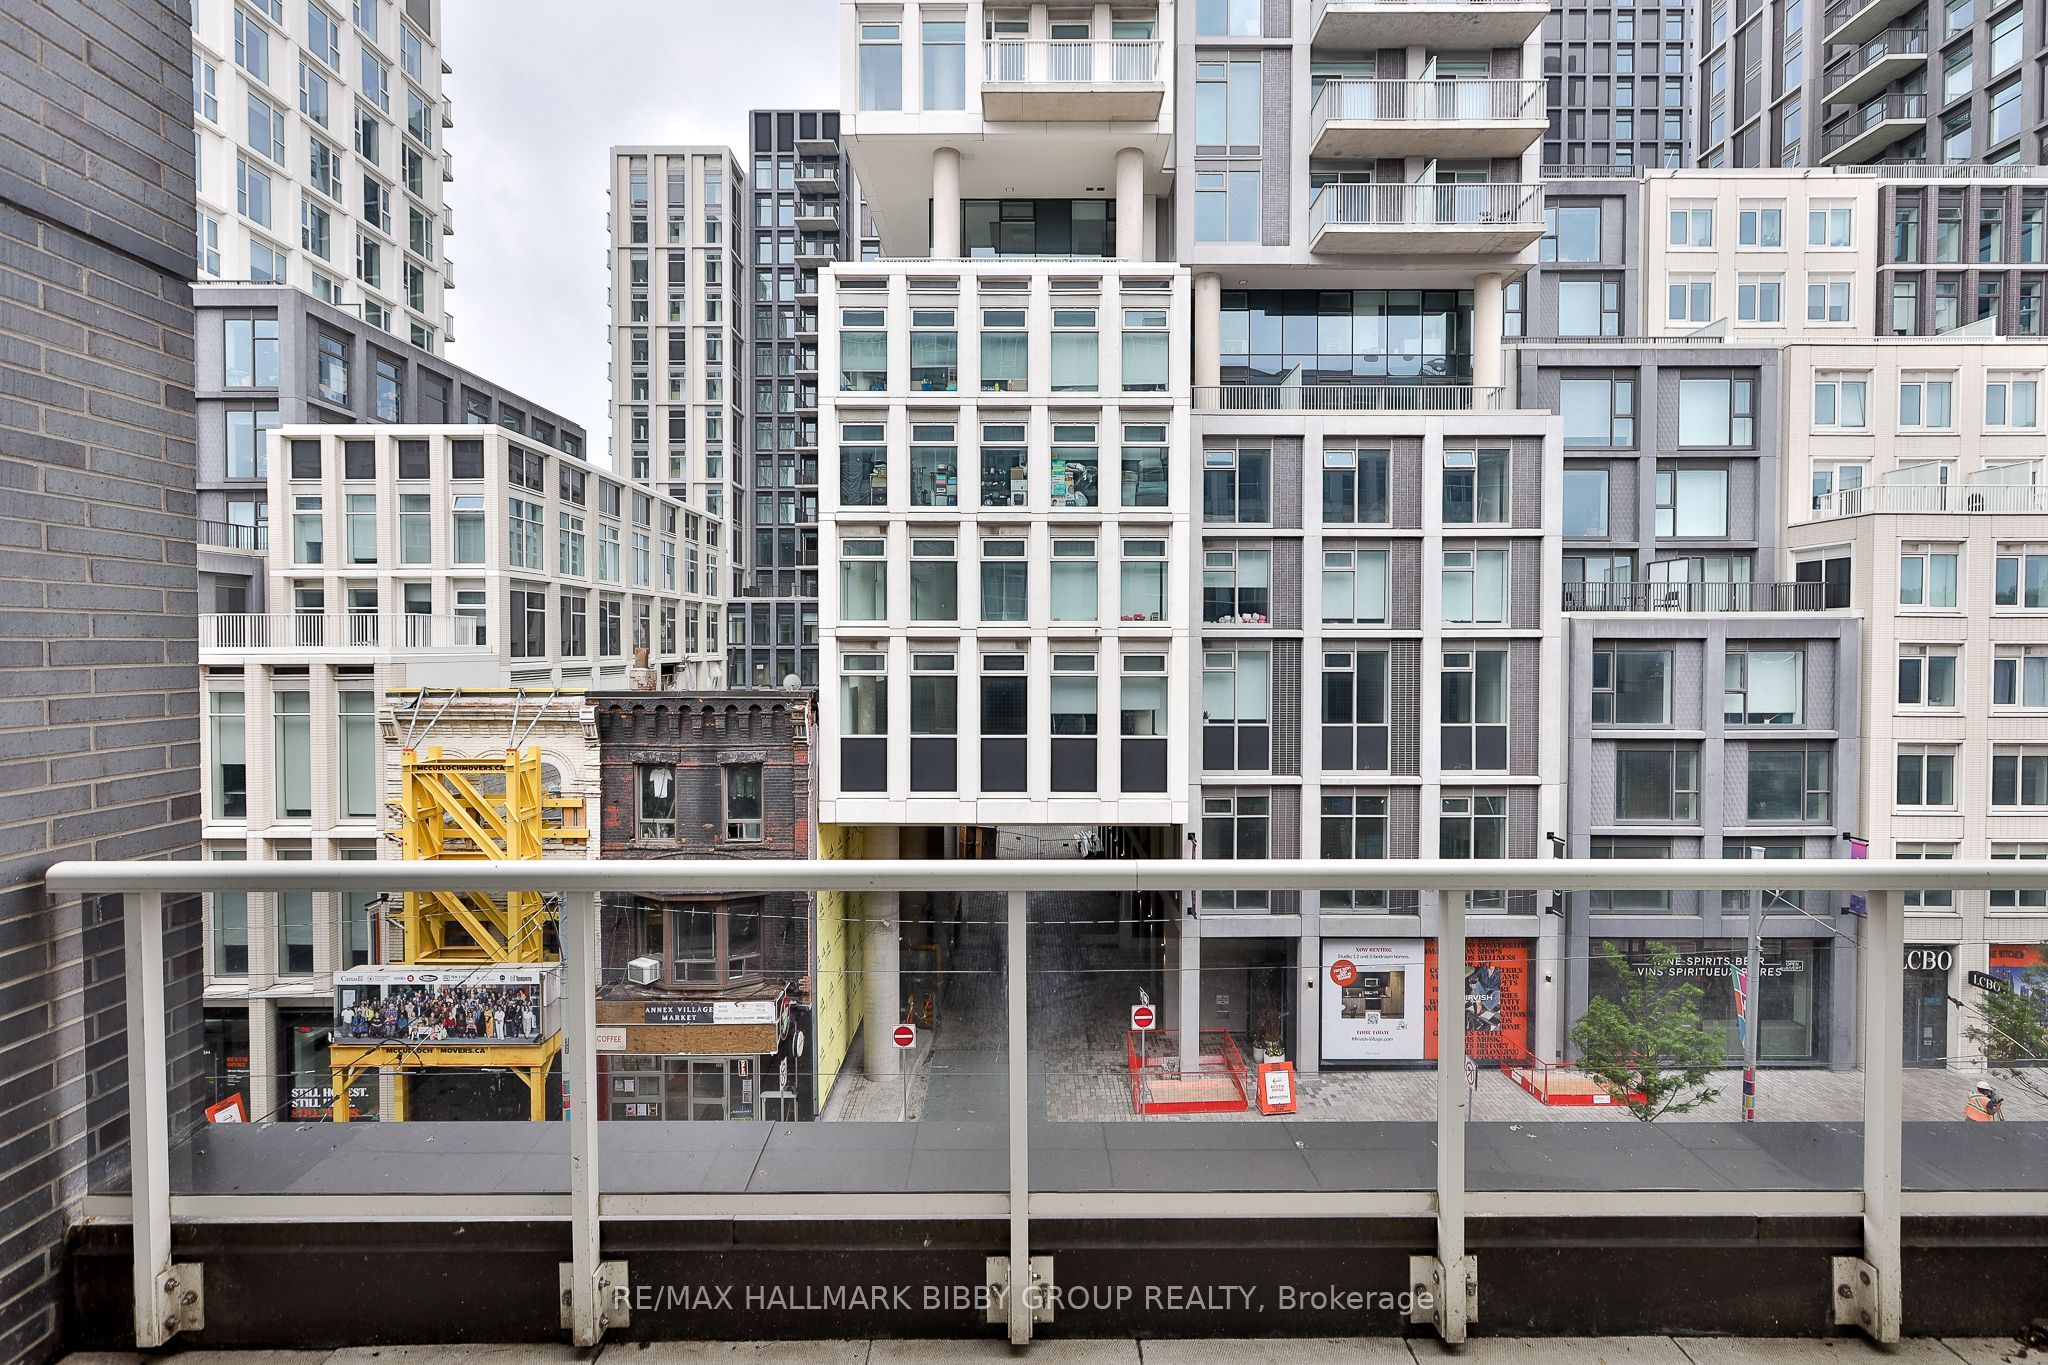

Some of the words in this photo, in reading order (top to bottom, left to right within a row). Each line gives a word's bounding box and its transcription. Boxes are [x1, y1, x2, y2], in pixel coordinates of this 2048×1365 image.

[1686, 957, 1731, 966] SPIRITS
[1735, 957, 1765, 966] BER
[596, 1035, 622, 1043] COFFEE
[291, 1087, 321, 1098] STILL
[323, 1087, 370, 1098] HEST.
[291, 1098, 321, 1108] STILL
